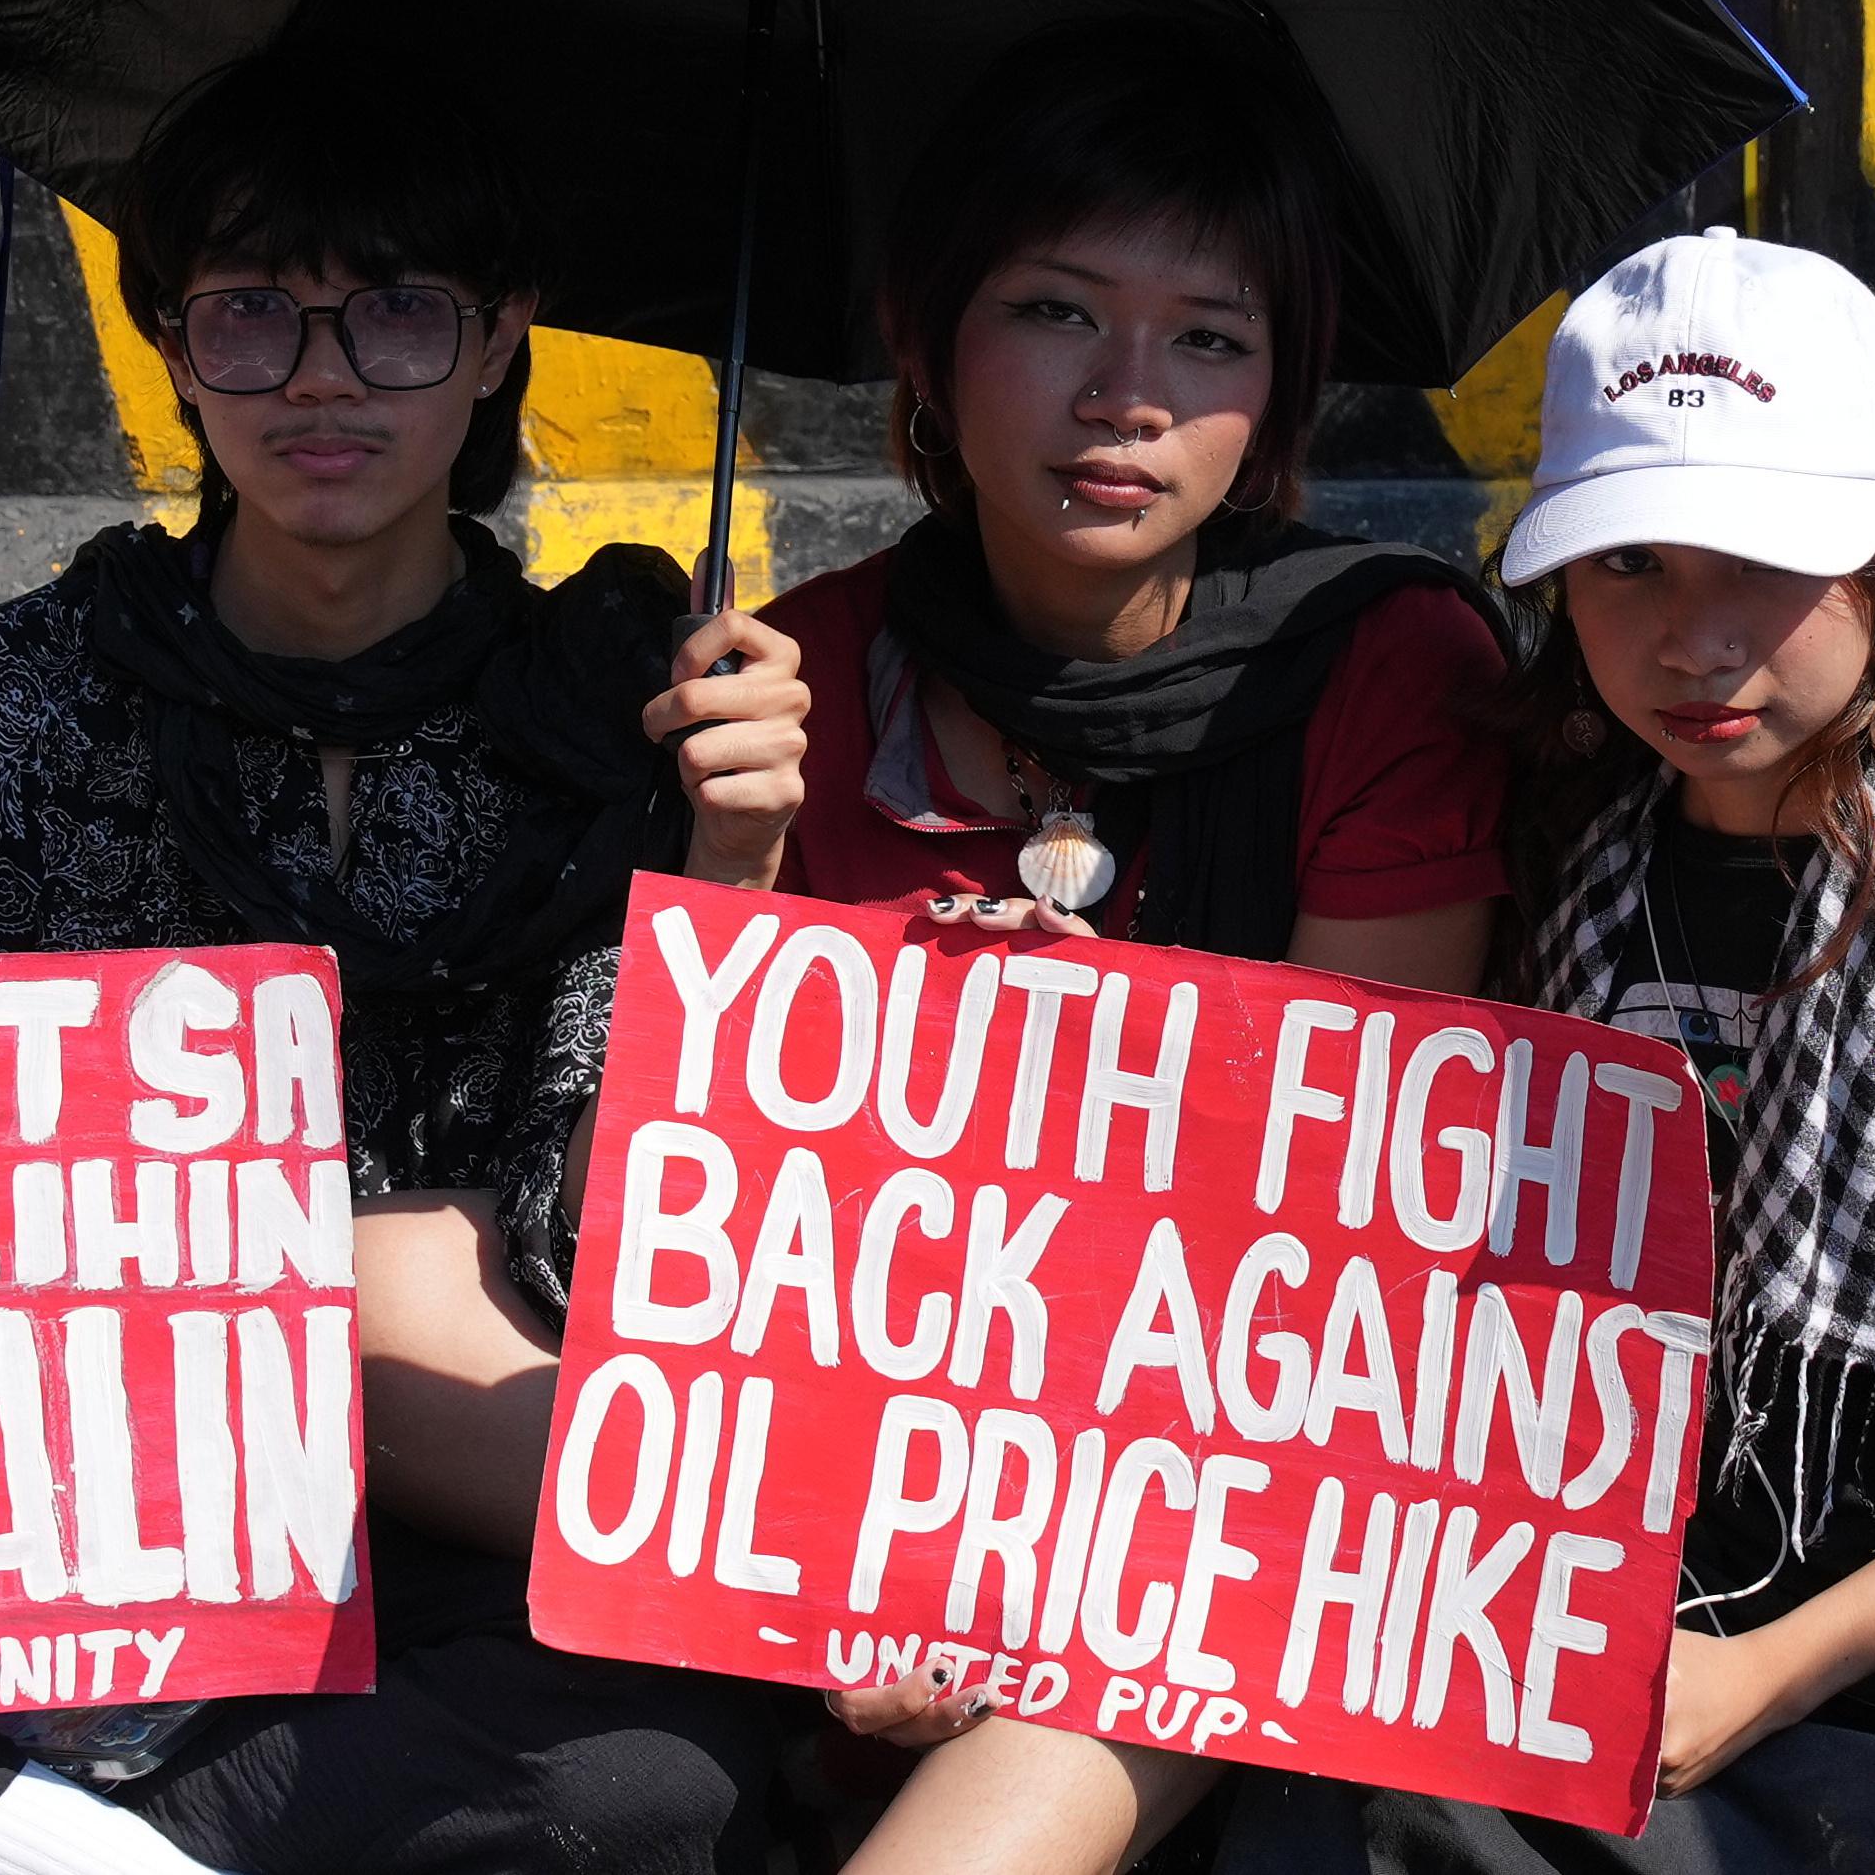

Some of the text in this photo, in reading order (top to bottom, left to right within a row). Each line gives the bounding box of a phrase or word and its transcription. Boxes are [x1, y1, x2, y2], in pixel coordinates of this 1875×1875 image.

[1603, 352, 1776, 403] LOS ANGELES
[1668, 388, 1705, 408] 83
[129, 961, 343, 1155] SA
[652, 905, 1683, 1291] YOUTH FIGHT
[612, 1122, 1712, 1534] BACK AGAINST
[556, 1353, 1627, 1764] OIL PRICE HIKE
[1096, 1675, 1248, 1753] PUP
